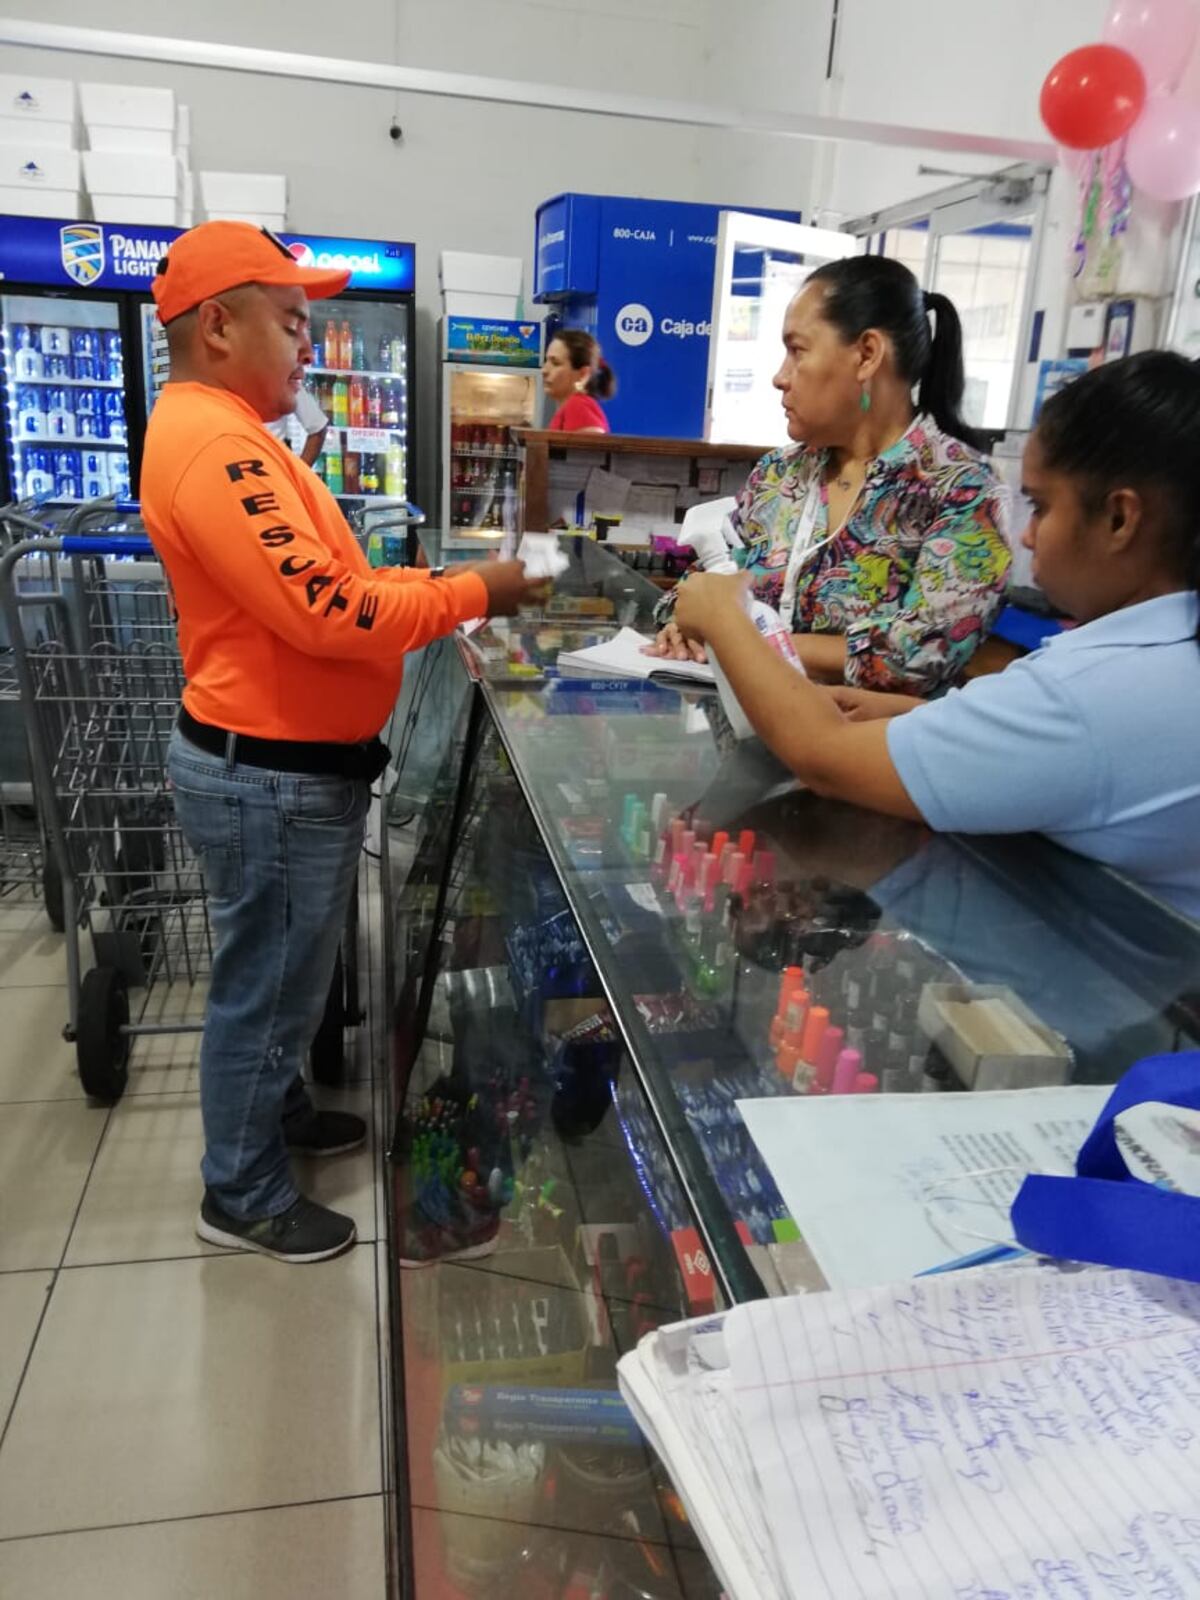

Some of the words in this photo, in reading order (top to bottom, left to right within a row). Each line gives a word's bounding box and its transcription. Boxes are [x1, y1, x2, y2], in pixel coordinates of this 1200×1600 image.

[613, 228, 656, 241] 800-CAJA
[114, 259, 159, 277] LIGHT
[660, 318, 694, 338] Caja
[695, 320, 712, 336] de
[225, 459, 379, 631] RESCATE
